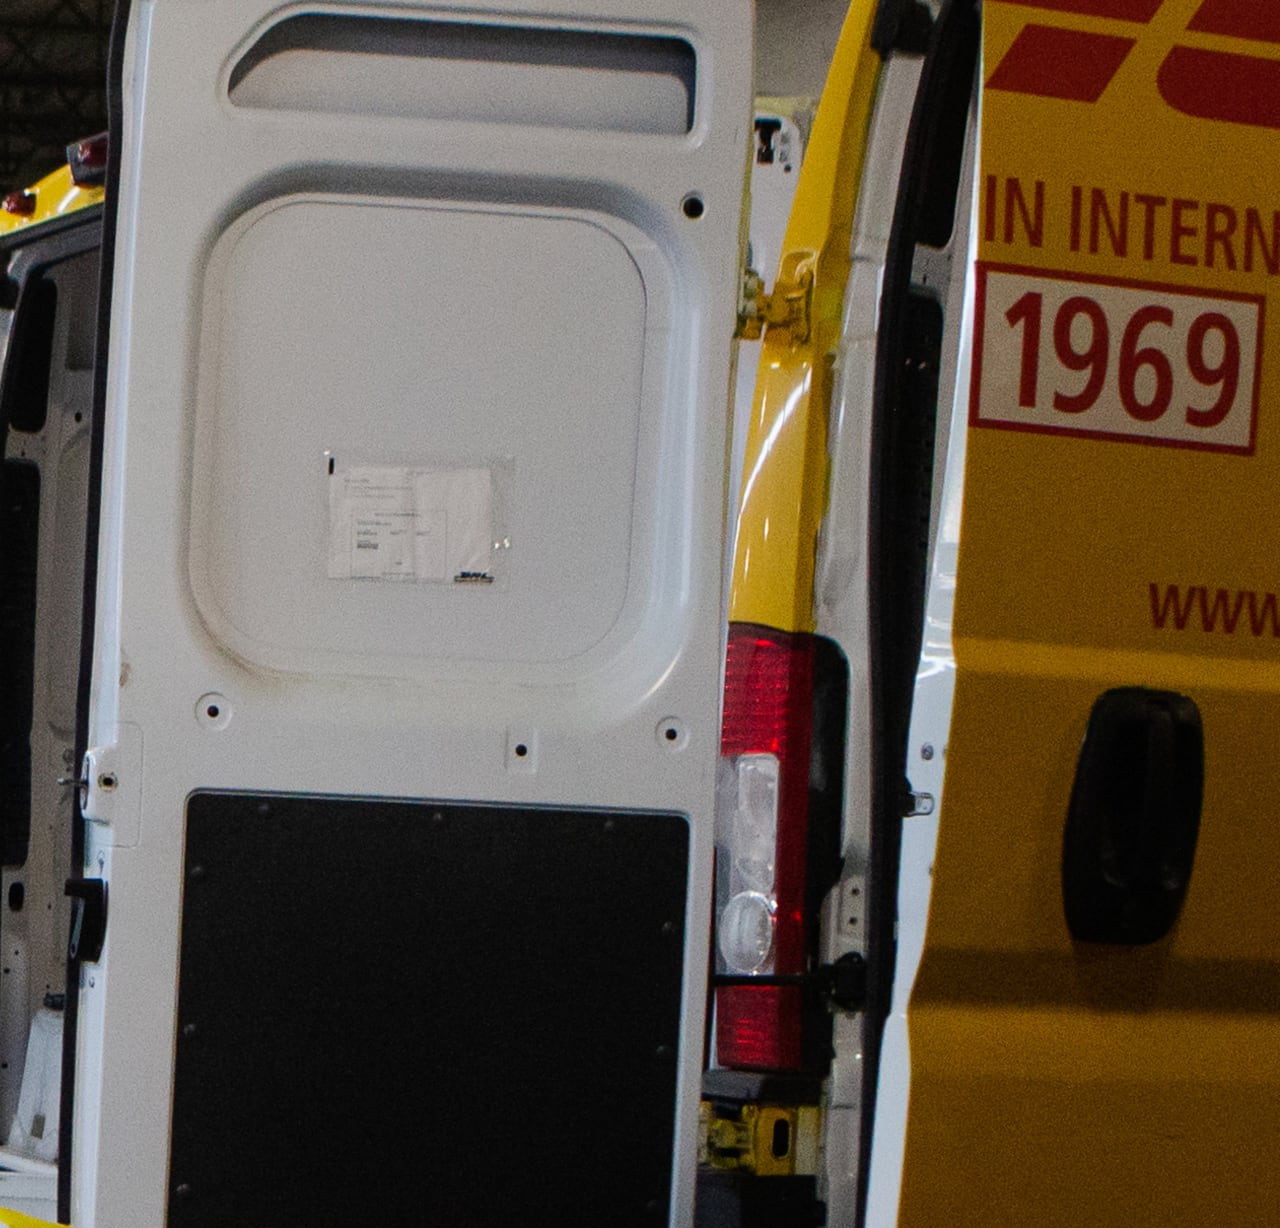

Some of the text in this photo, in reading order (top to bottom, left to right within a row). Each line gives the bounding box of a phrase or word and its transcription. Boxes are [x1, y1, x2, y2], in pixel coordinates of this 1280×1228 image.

[984, 174, 1044, 248] IN
[1004, 291, 1240, 428] 1969
[1149, 583, 1280, 638] www
